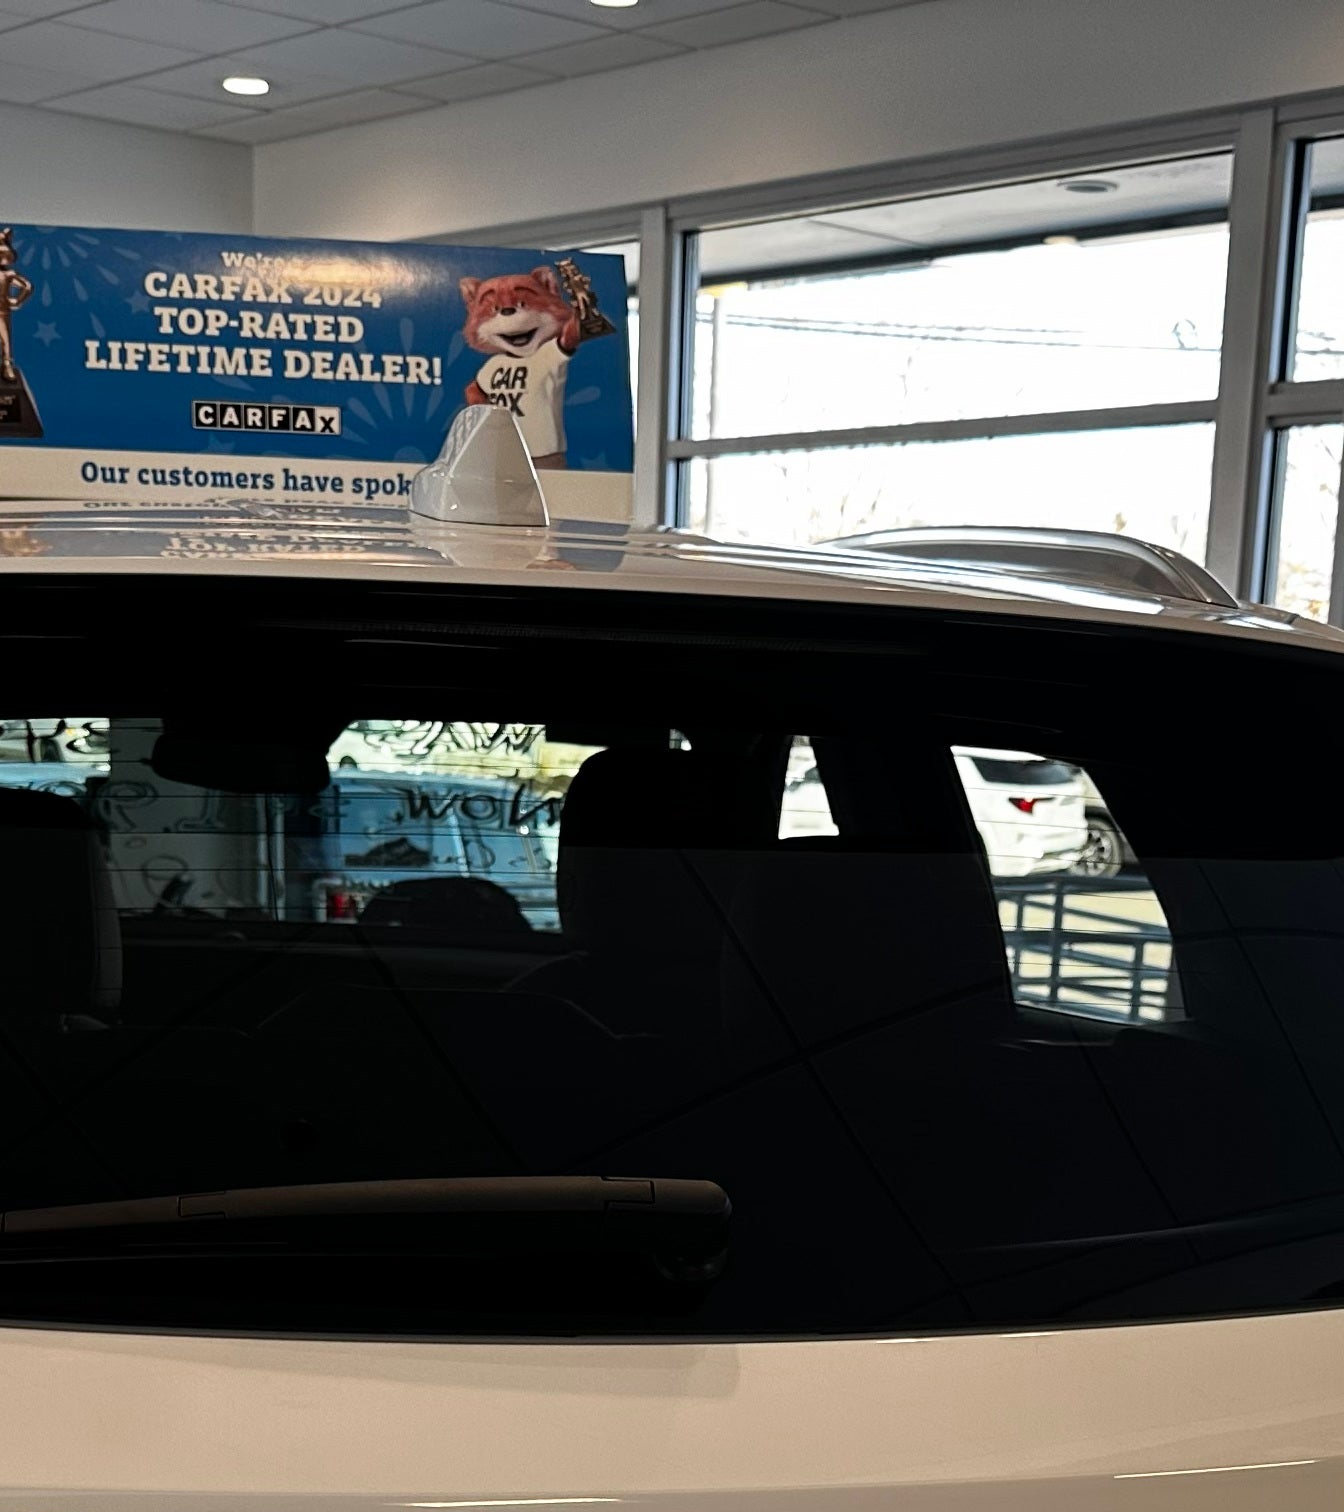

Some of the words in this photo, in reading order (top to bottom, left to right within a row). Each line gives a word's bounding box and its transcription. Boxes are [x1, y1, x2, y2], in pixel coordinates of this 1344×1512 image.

[144, 271, 293, 305] CARFAX
[303, 281, 383, 309] 2024
[153, 306, 365, 344] TOP-RATED
[84, 340, 274, 378] LIFETIME
[283, 349, 443, 386] DEALER!
[490, 366, 528, 390] CAR
[197, 404, 336, 434] CARFAX
[80, 461, 130, 485] Our
[137, 465, 275, 490] customers
[282, 468, 344, 495] have
[352, 473, 413, 500] spok
